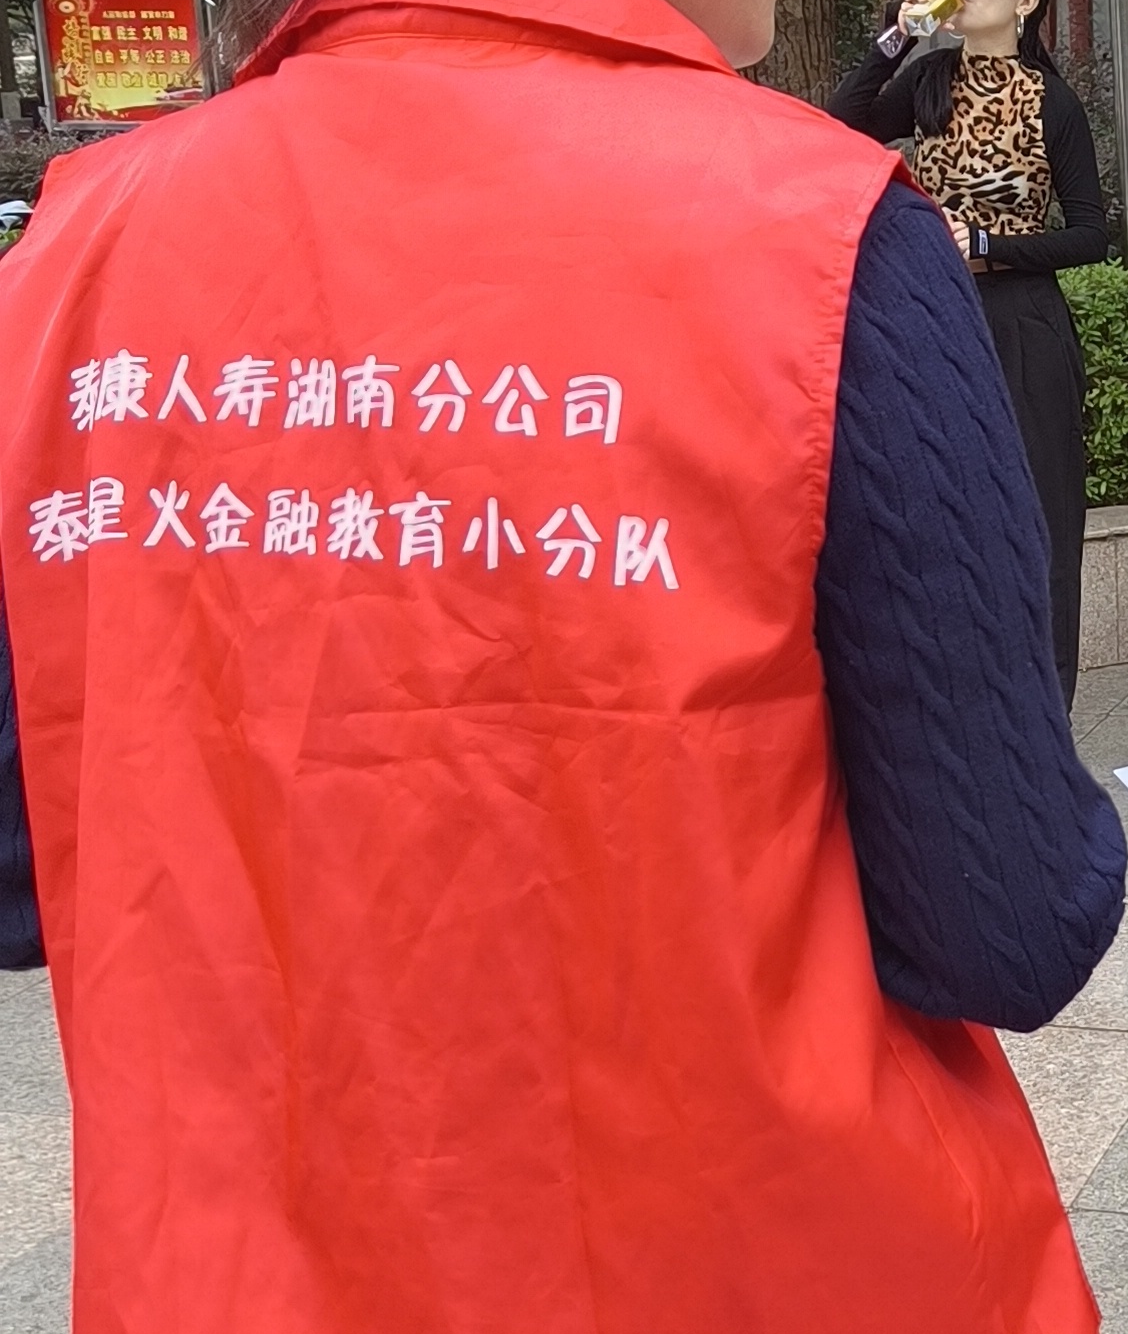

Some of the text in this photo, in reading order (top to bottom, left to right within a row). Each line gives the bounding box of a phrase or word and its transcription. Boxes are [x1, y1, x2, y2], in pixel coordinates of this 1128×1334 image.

[29, 476, 680, 589] 泰星火金融教育小分队
